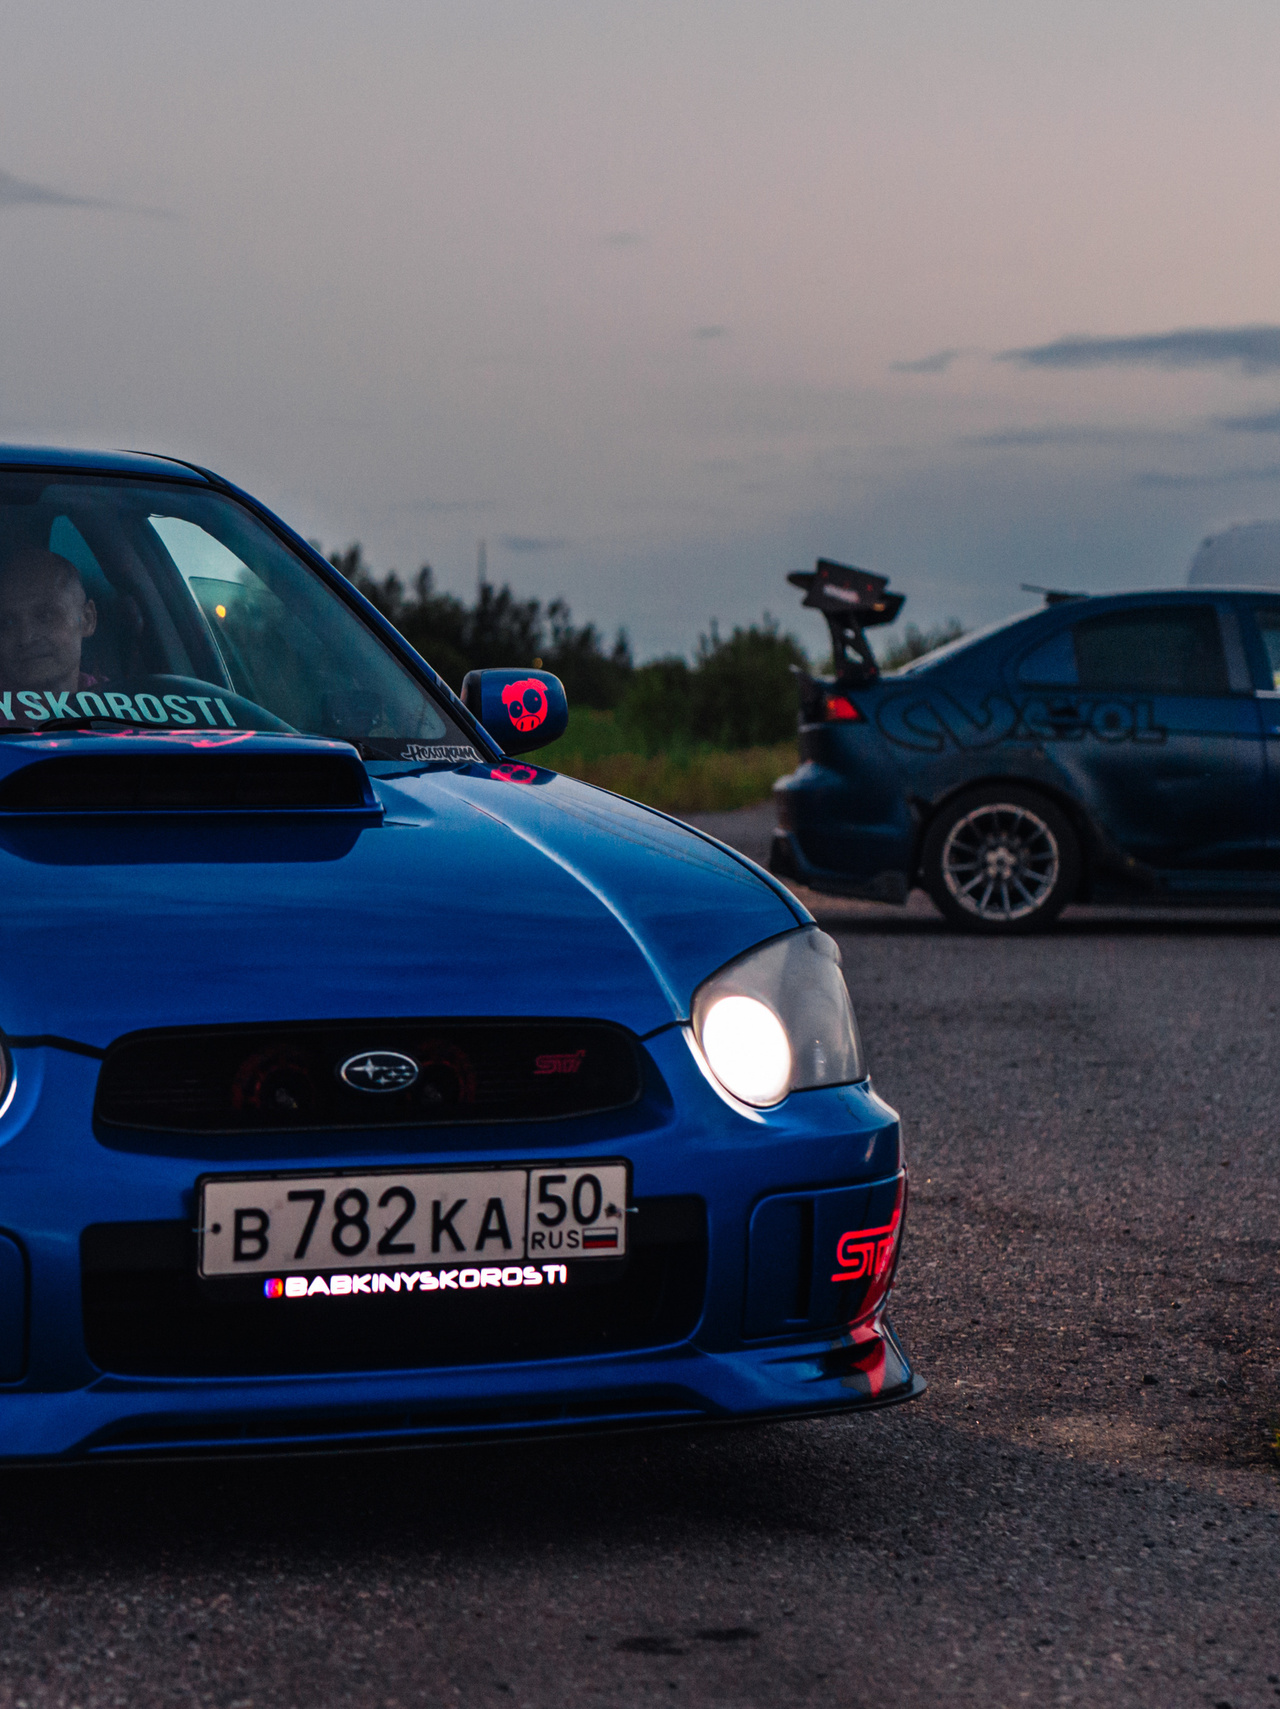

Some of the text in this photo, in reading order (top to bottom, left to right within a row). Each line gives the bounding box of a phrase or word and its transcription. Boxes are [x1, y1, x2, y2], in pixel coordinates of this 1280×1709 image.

[536, 1173, 603, 1227] 50
[531, 1229, 581, 1251] RUS
[285, 1264, 568, 1298] BABKINYSKOROSTI
